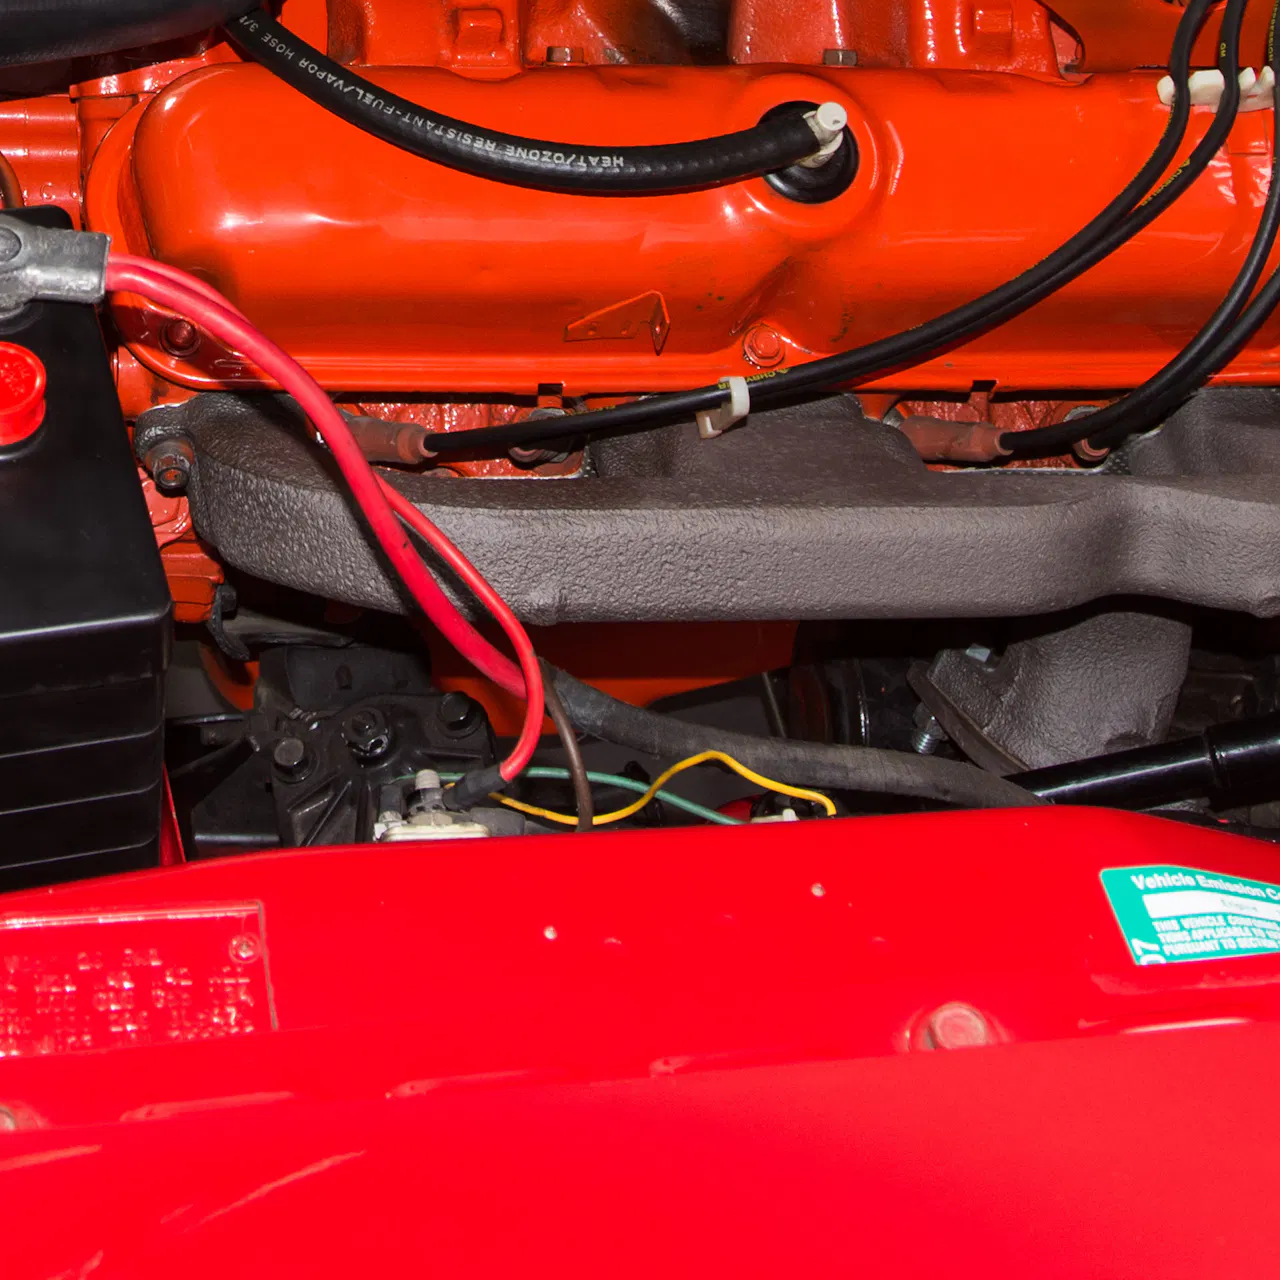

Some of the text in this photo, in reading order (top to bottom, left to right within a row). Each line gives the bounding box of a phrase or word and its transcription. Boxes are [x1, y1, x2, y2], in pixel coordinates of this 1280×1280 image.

[261, 32, 295, 61] HOSE
[298, 57, 498, 152] RESISTANT-FUEL/VAPOR
[504, 145, 624, 168] HEAT/OZONE
[1130, 872, 1197, 890] Vehicle
[1197, 874, 1267, 899] Emission
[1152, 919, 1182, 932] THIS
[1180, 914, 1227, 929] VEHICLE
